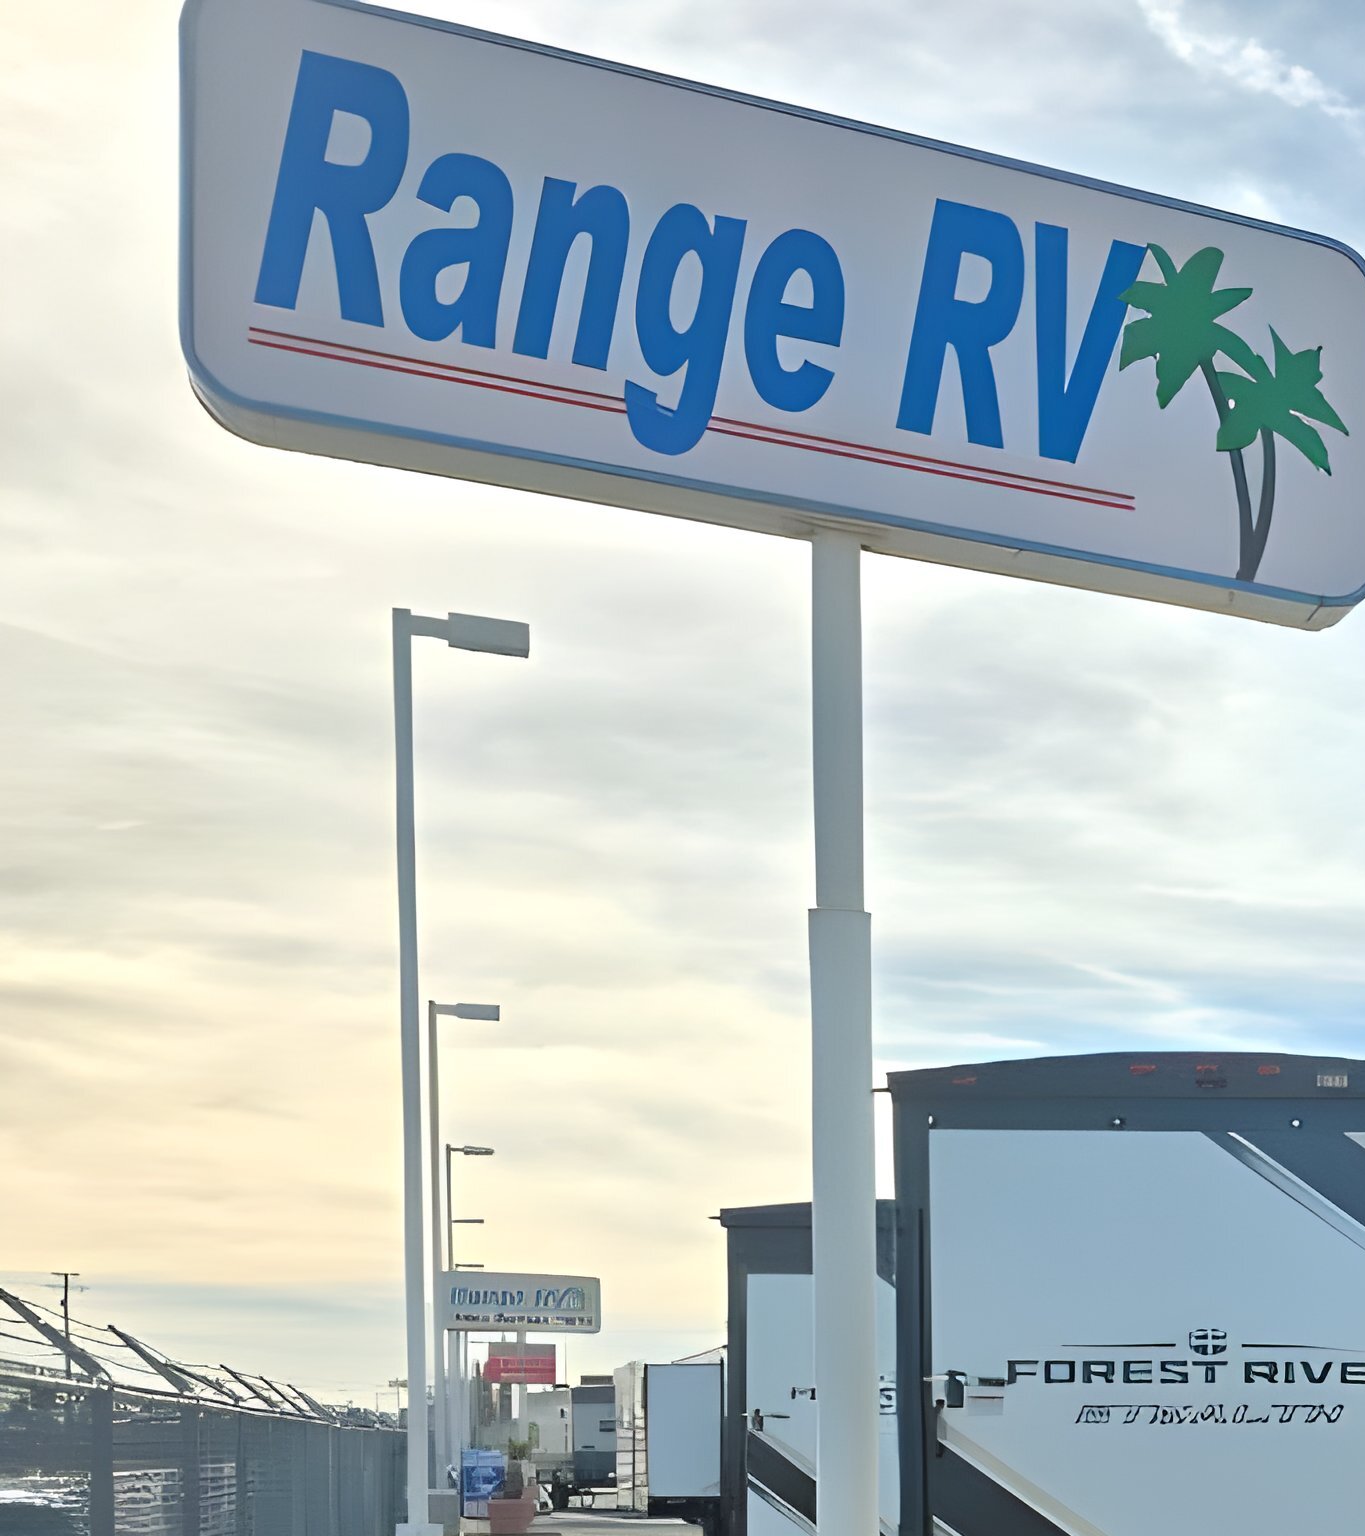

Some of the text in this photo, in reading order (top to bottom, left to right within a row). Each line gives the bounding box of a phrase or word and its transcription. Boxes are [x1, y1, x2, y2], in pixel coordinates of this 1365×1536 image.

[254, 48, 1148, 464] Range RV
[1007, 1360, 1228, 1385] FOREST
